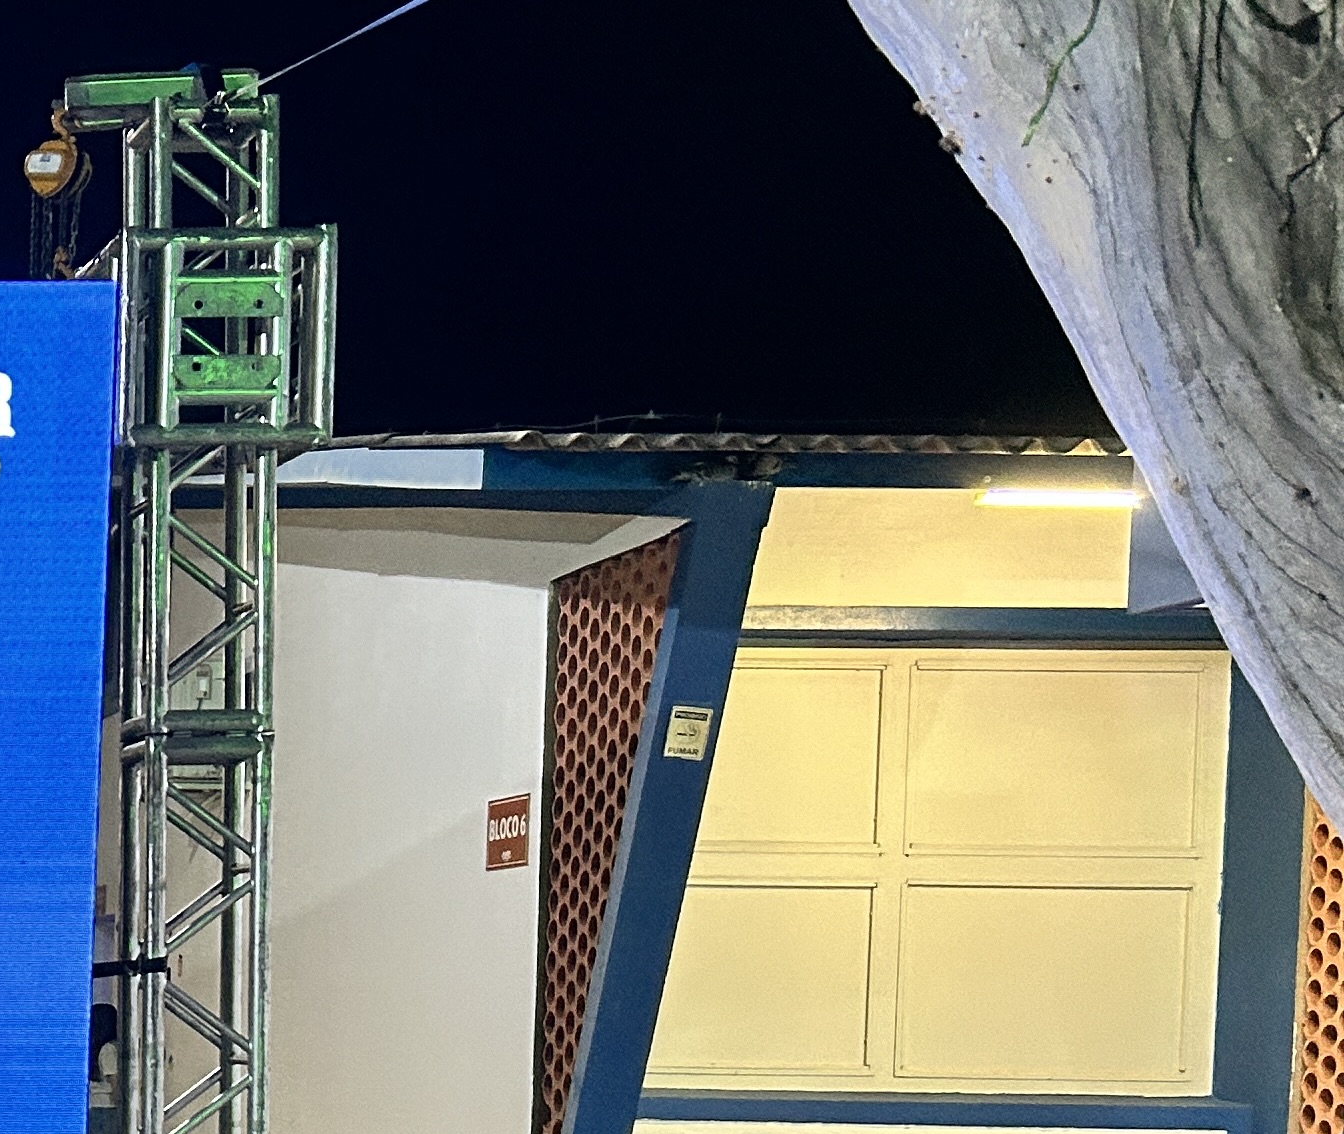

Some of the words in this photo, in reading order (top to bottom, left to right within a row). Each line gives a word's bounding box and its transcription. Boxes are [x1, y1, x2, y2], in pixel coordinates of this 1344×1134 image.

[667, 746, 699, 755] FUMAR
[489, 814, 519, 842] BLOCO
[520, 813, 527, 836] 6
